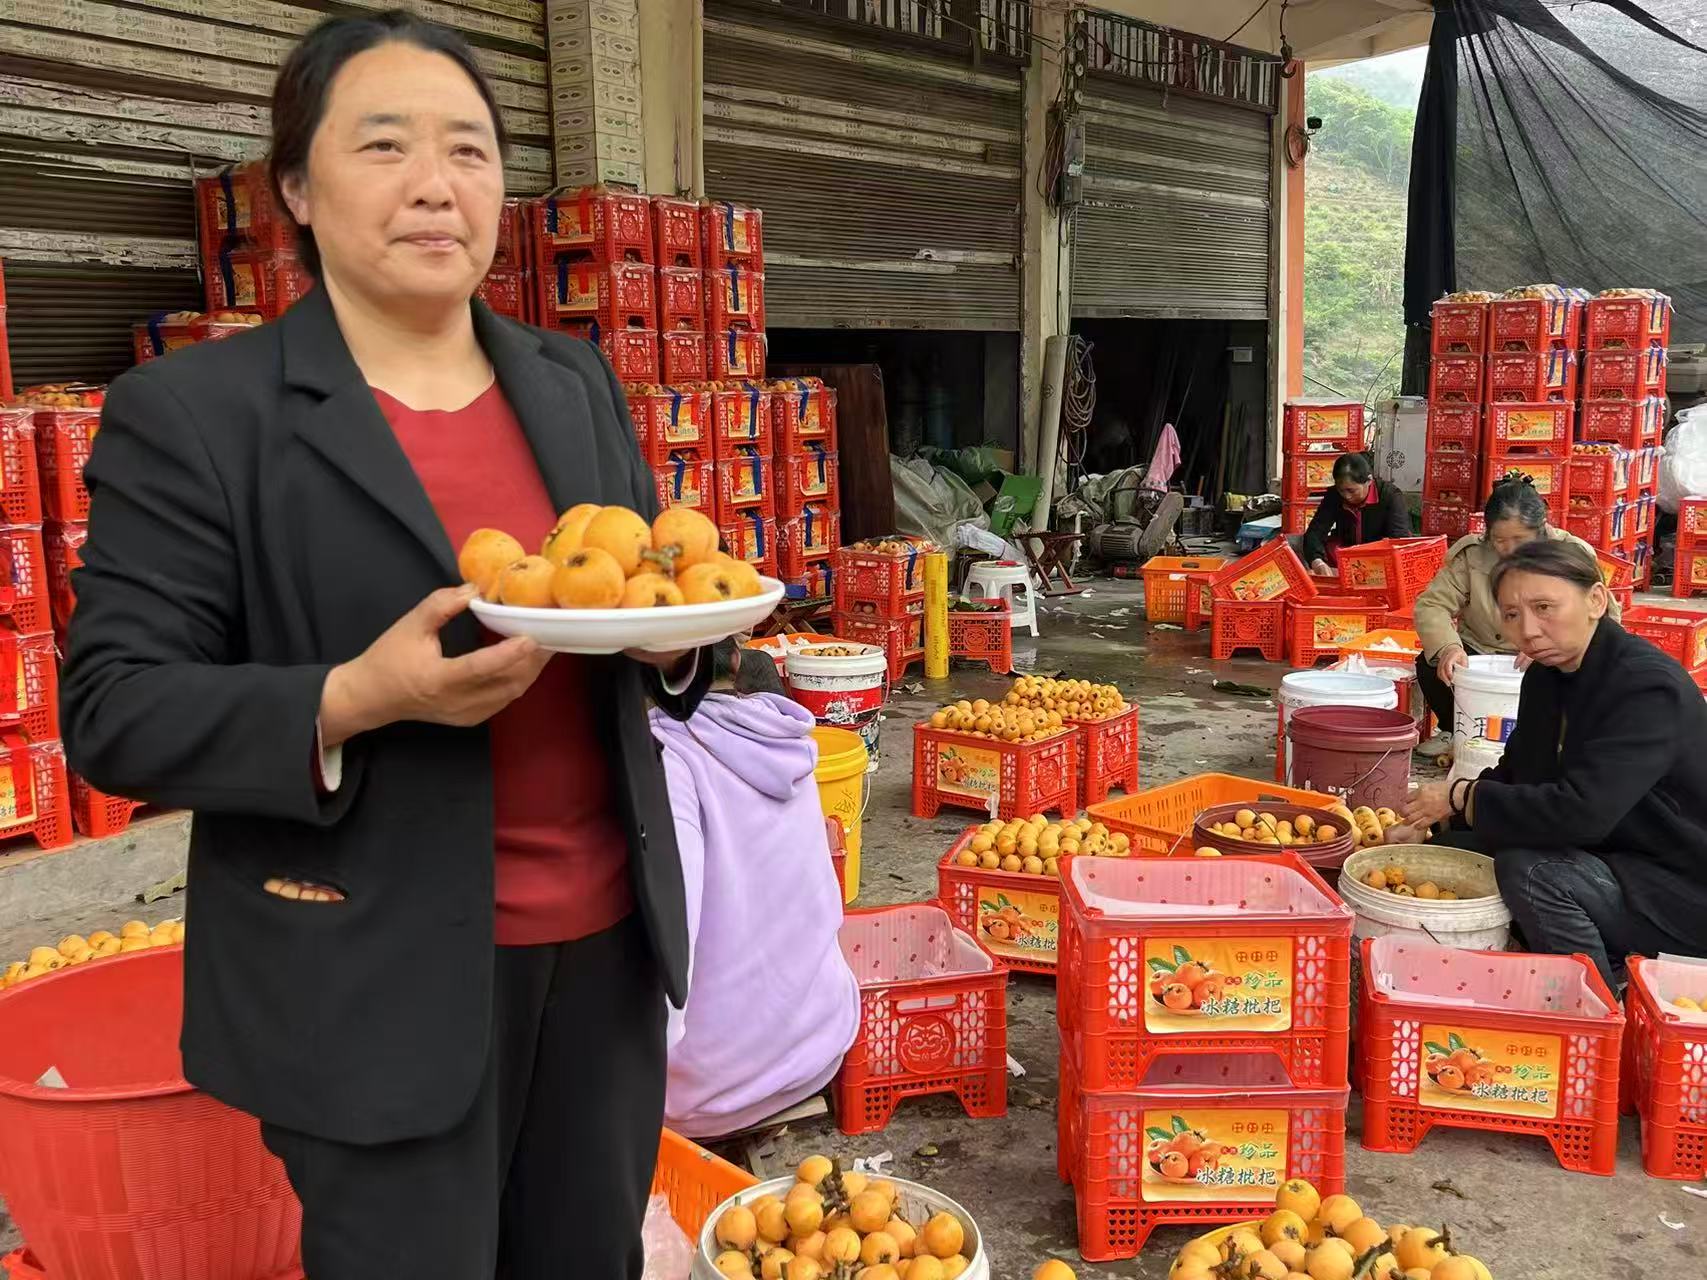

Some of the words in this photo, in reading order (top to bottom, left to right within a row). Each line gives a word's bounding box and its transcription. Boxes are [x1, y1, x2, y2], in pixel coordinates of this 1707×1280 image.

[1244, 970, 1283, 990] 珍品
[1200, 997, 1282, 1016] 冰糖枇杷
[1513, 1063, 1552, 1080] 珍品
[1471, 1081, 1549, 1103] 冰糖枇杷
[1239, 1142, 1279, 1161] 珍品
[1196, 1166, 1277, 1185] 冰糖枇杷
